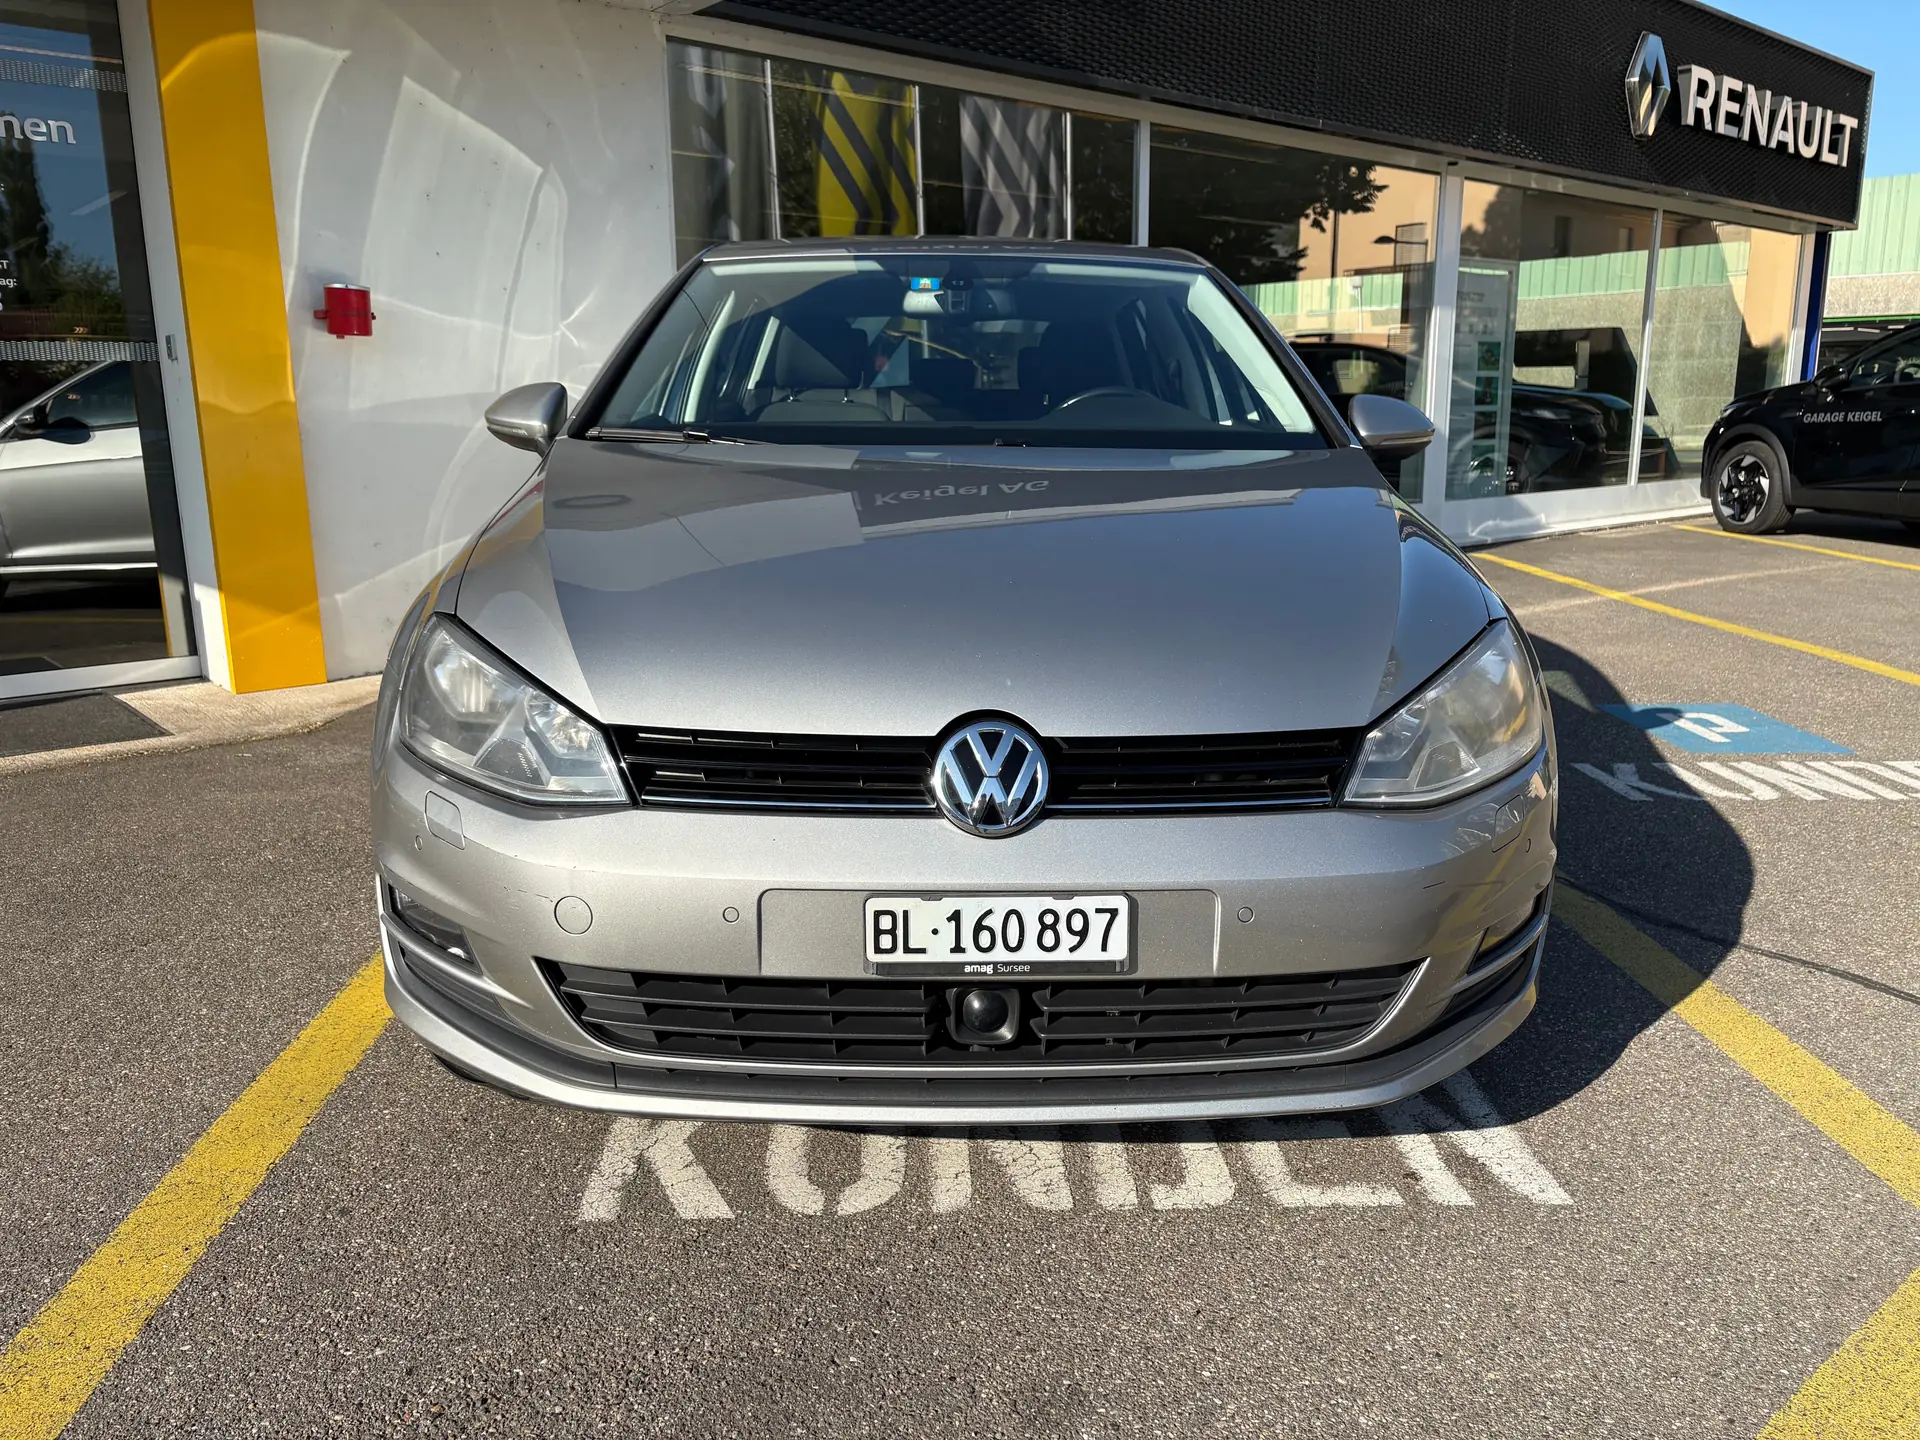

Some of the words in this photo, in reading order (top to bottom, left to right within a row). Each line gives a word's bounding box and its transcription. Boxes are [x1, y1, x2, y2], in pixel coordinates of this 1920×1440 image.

[1677, 64, 1859, 168] RENAULT
[1803, 411, 1845, 424] GARAGE
[1847, 410, 1882, 422] KEIGEL
[1656, 712, 1750, 743] P
[1570, 760, 1920, 801] KUND
[964, 963, 994, 975] amag
[997, 963, 1031, 973] Sursee
